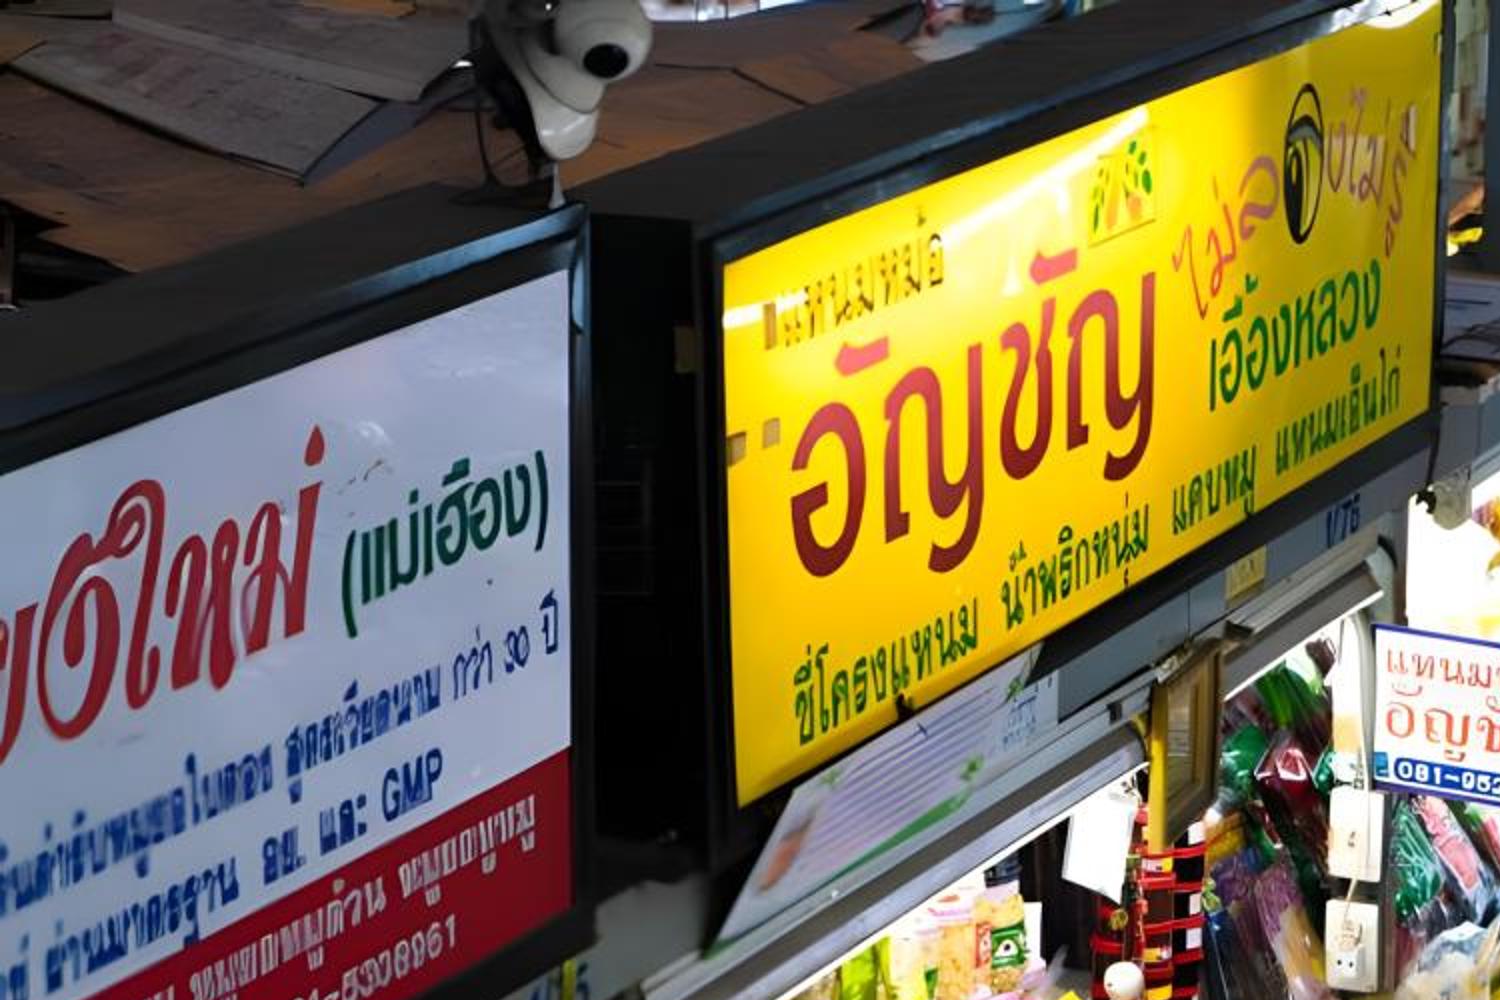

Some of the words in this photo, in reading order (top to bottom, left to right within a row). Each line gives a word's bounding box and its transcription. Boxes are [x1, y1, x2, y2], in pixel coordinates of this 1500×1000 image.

[1208, 259, 1382, 412] เอื้องหลวง
[790, 248, 1157, 579] อัญชัญ
[1000, 491, 1149, 631] น้ำพริกหนุ่ม
[1172, 444, 1257, 535] แคบหมู
[540, 589, 559, 655] ปี
[382, 748, 443, 822] GMP
